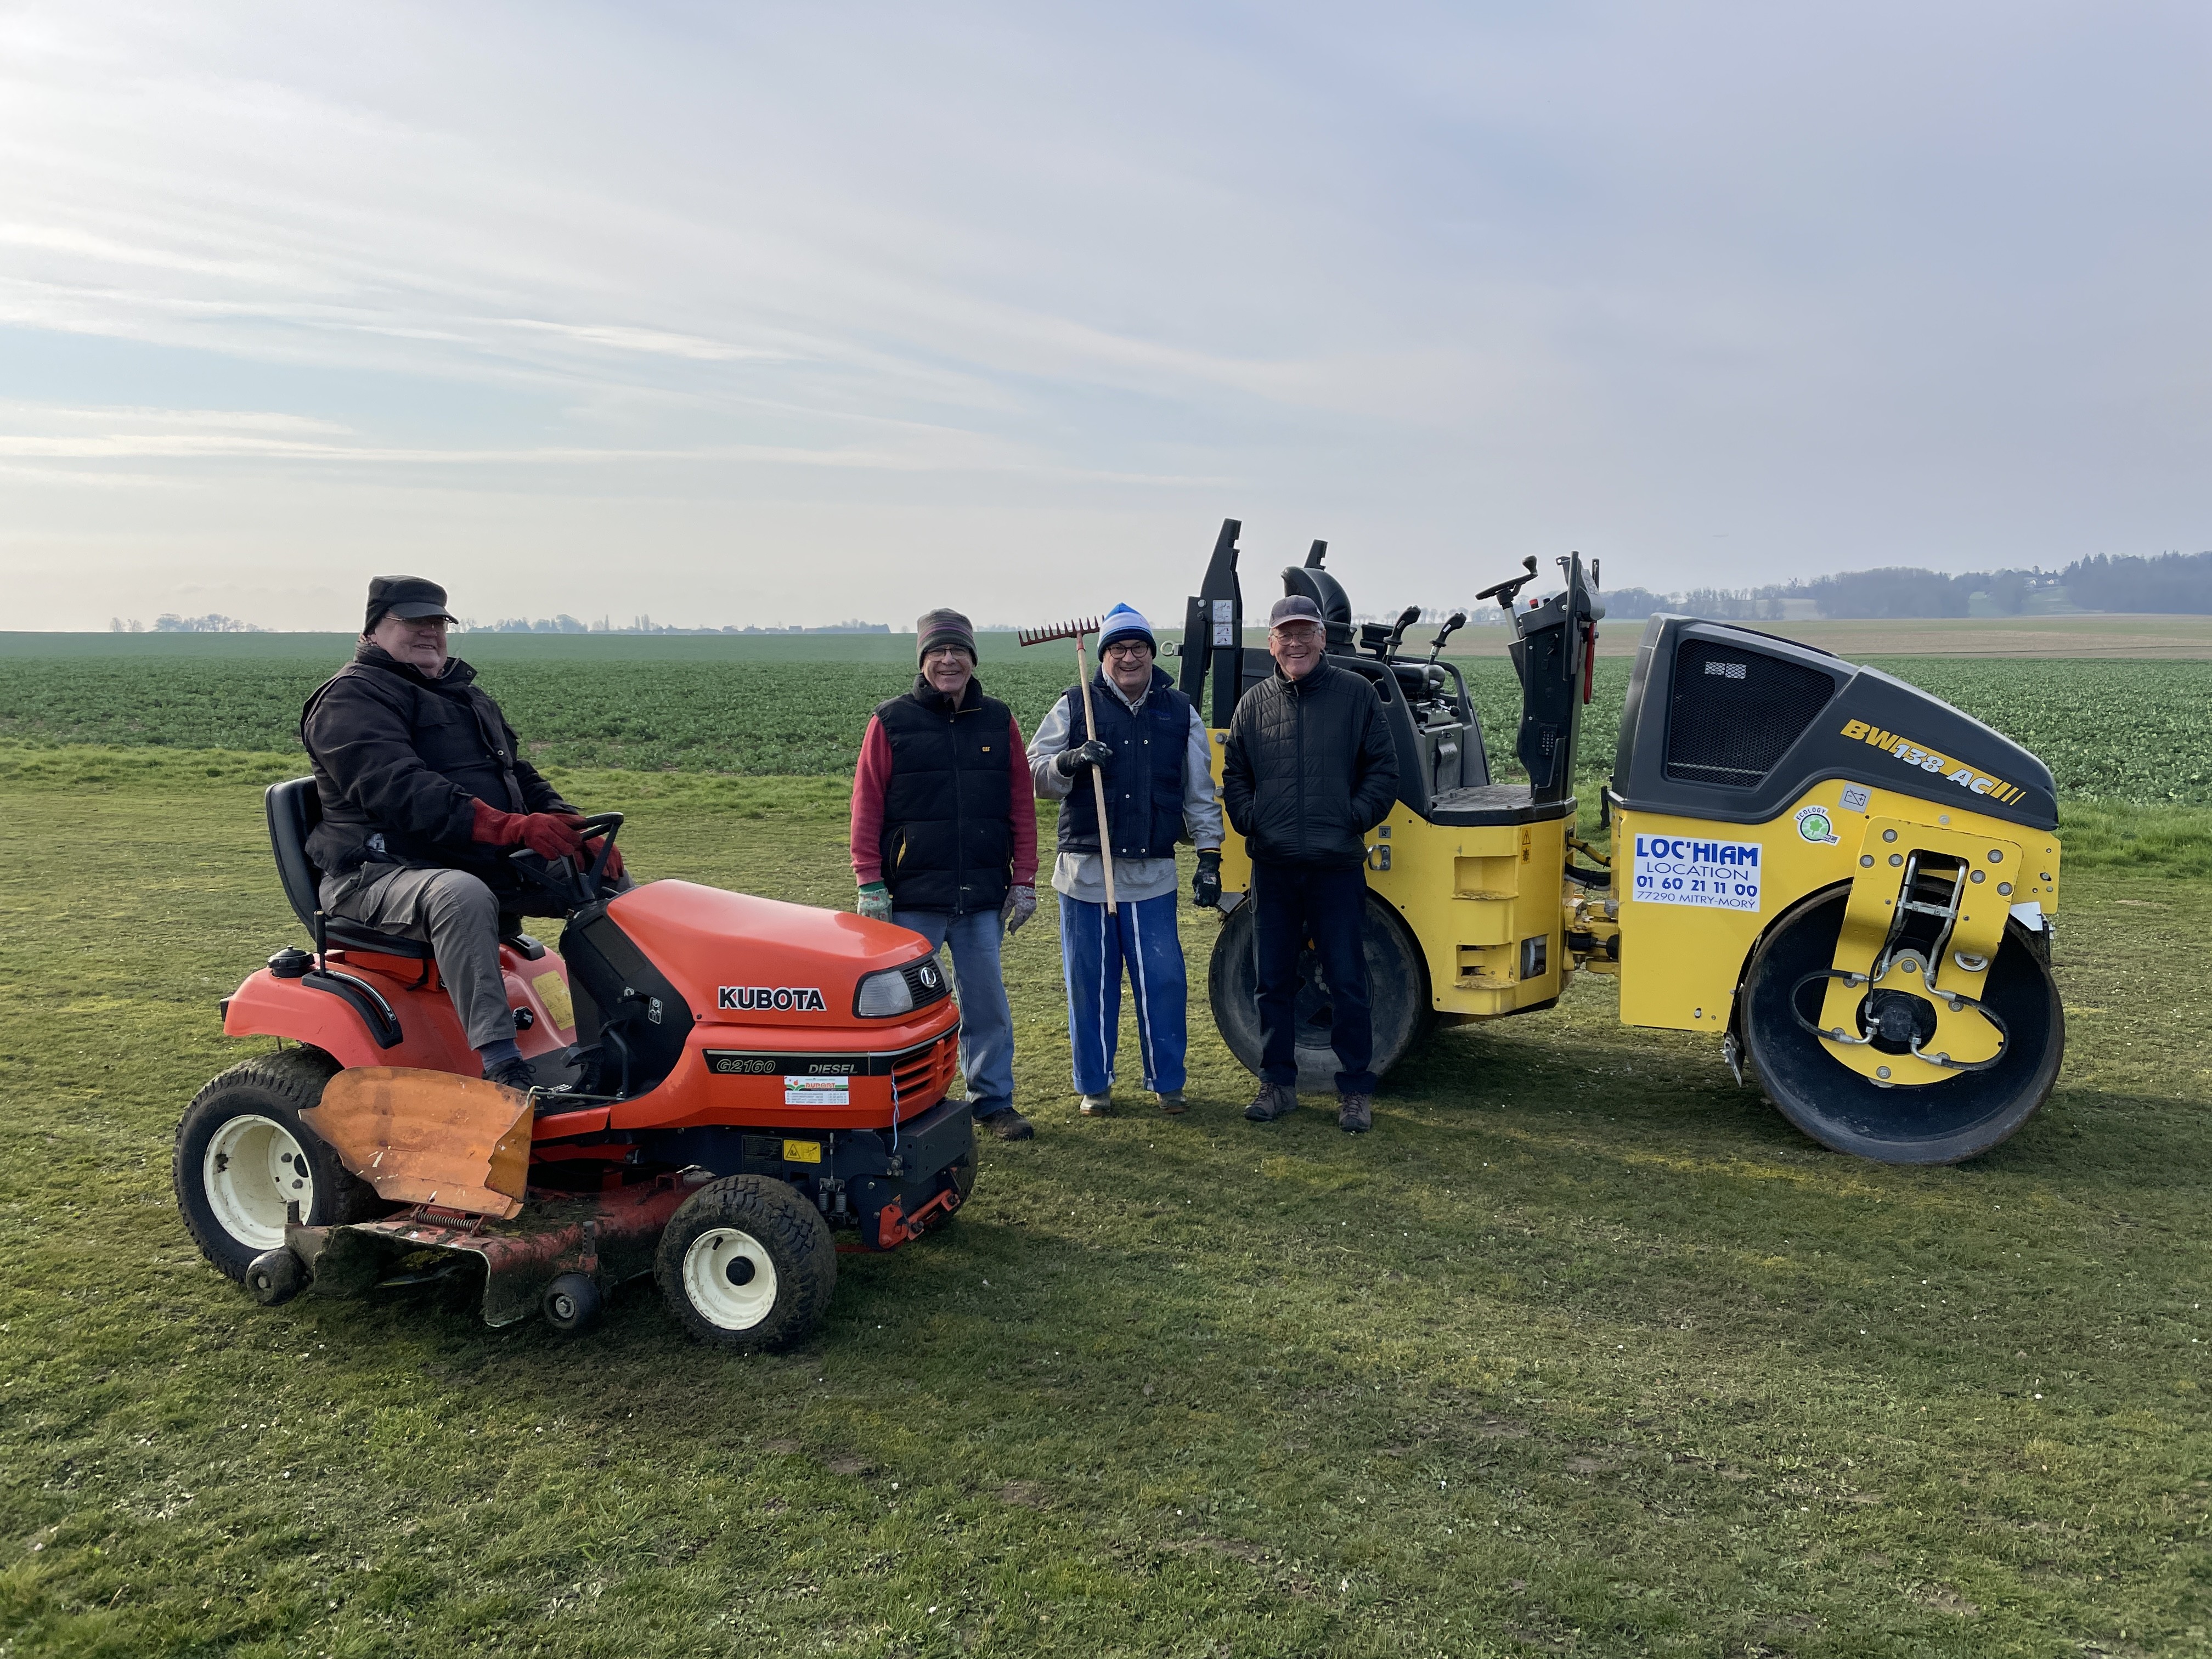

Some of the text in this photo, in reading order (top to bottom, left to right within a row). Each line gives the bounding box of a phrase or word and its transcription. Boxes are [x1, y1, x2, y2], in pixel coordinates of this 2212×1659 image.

[1796, 807, 1826, 821] ECOLOGY
[1637, 838, 1758, 867] LOC'HIAM
[1646, 862, 1748, 881] LOCATION
[1637, 876, 1757, 897] 01 60 21 11 00
[1637, 891, 1756, 909] 77290 MITRY-MORY
[719, 986, 827, 1011] KUBOTA
[716, 1059, 858, 1074] G2160 DIESEL
